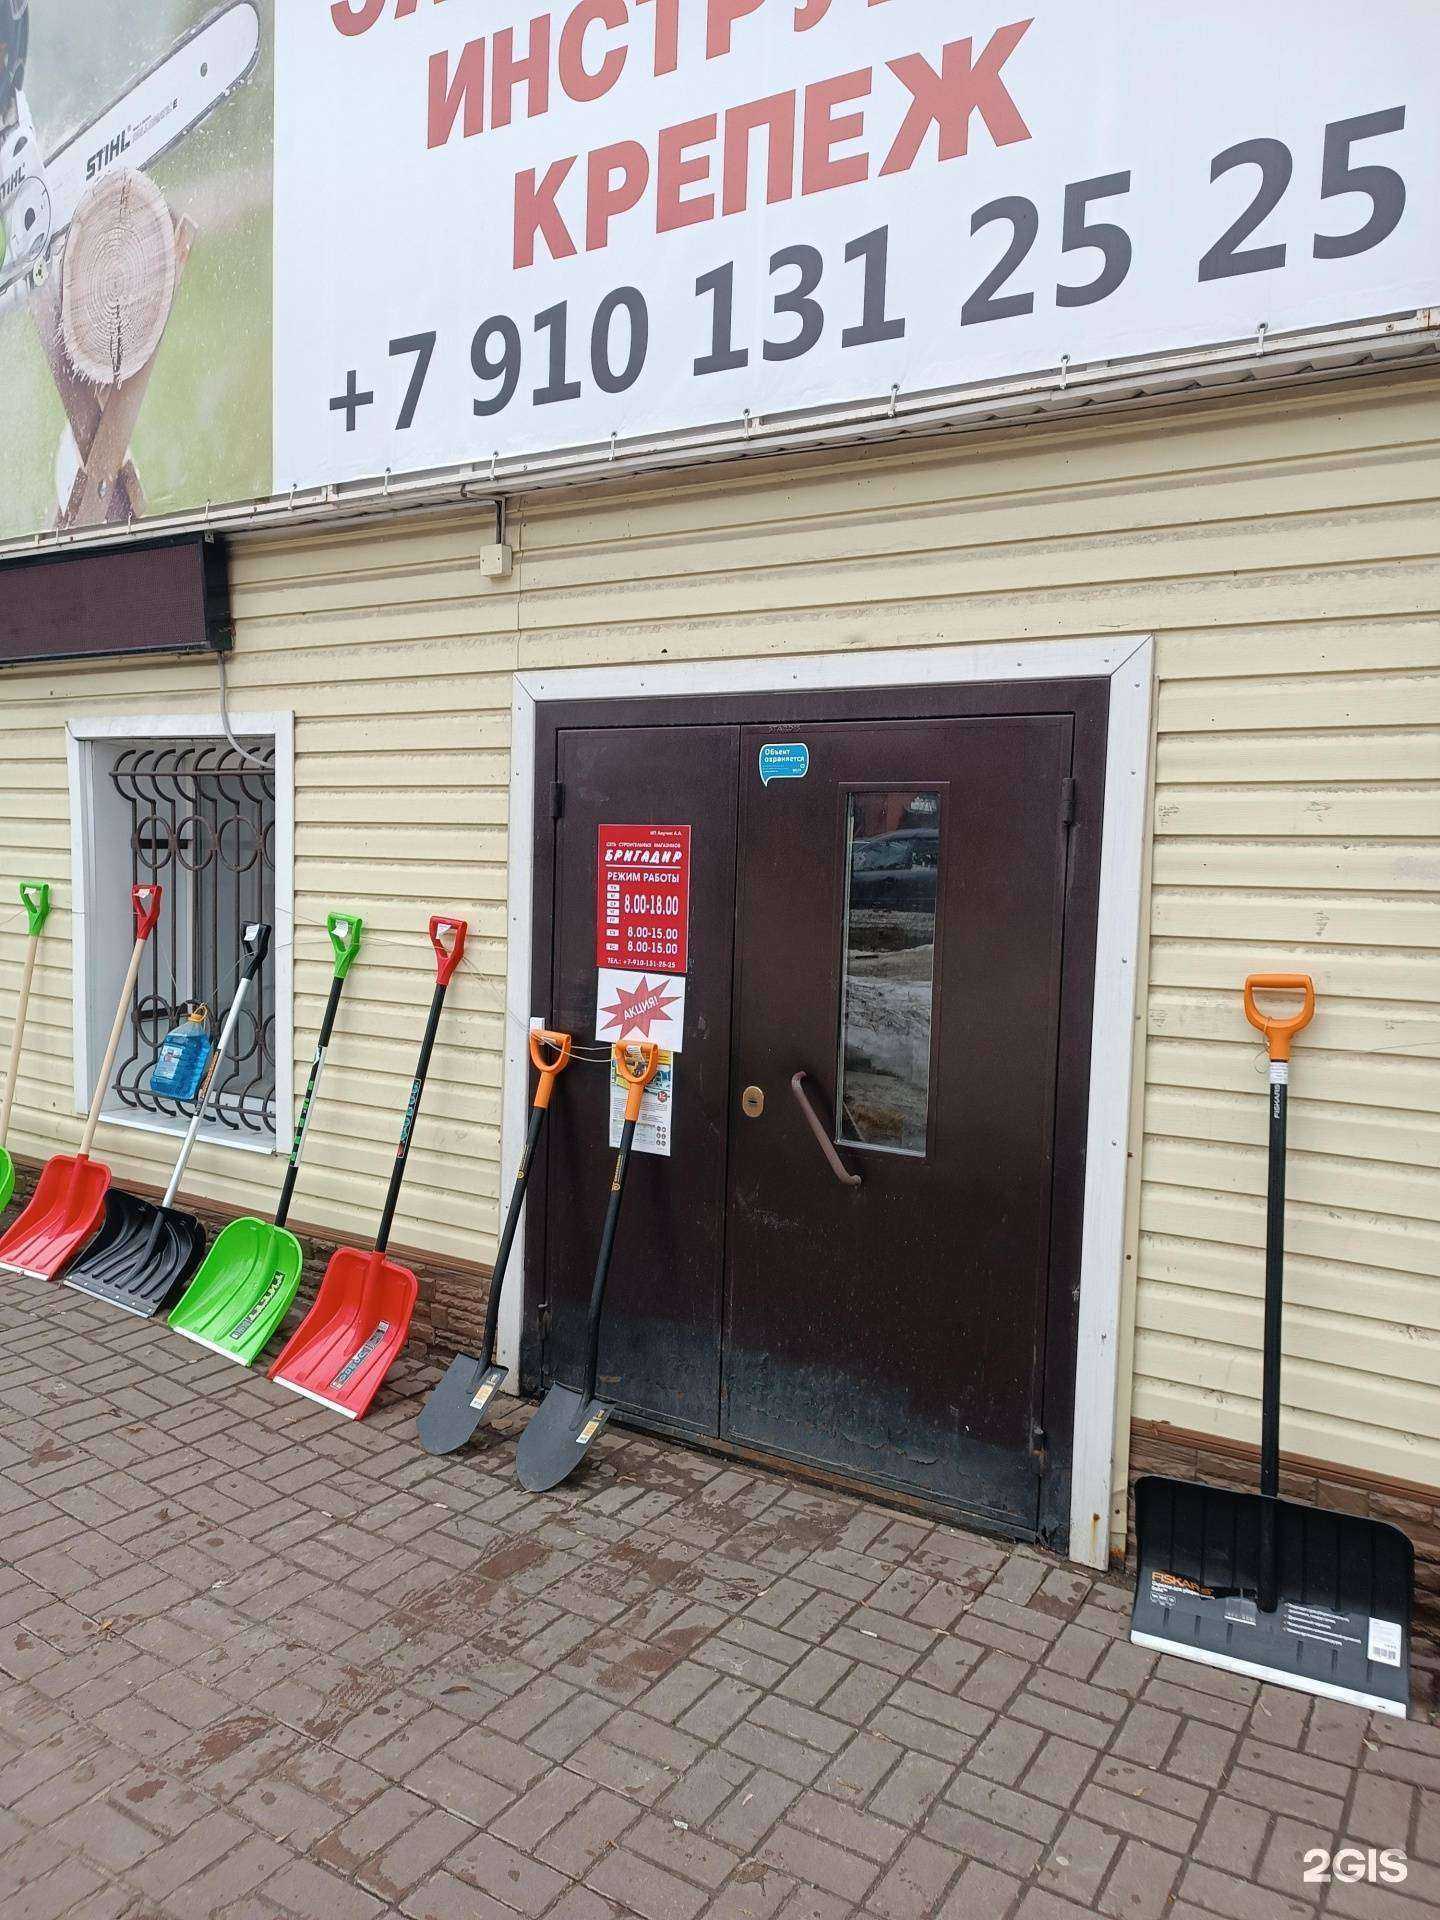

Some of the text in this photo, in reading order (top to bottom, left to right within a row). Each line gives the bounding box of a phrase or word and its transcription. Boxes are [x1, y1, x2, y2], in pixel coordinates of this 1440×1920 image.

[427, 0, 891, 149] ИНСТР
[86, 129, 130, 181] STIHL
[513, 18, 1035, 270] КРЕПЕЖ
[0, 166, 26, 202] TIHL
[329, 104, 1407, 432] +7 910 131 25 25
[604, 849, 683, 864] БРИГАДИР
[607, 871, 680, 883] РЕЖИМ РАБОТЫ
[624, 894, 679, 916] 8.00-18.00
[627, 926, 678, 940] 8.00-15.00
[627, 941, 678, 954] 8.00-15.00
[624, 995, 659, 1020] АКЦИЯ!
